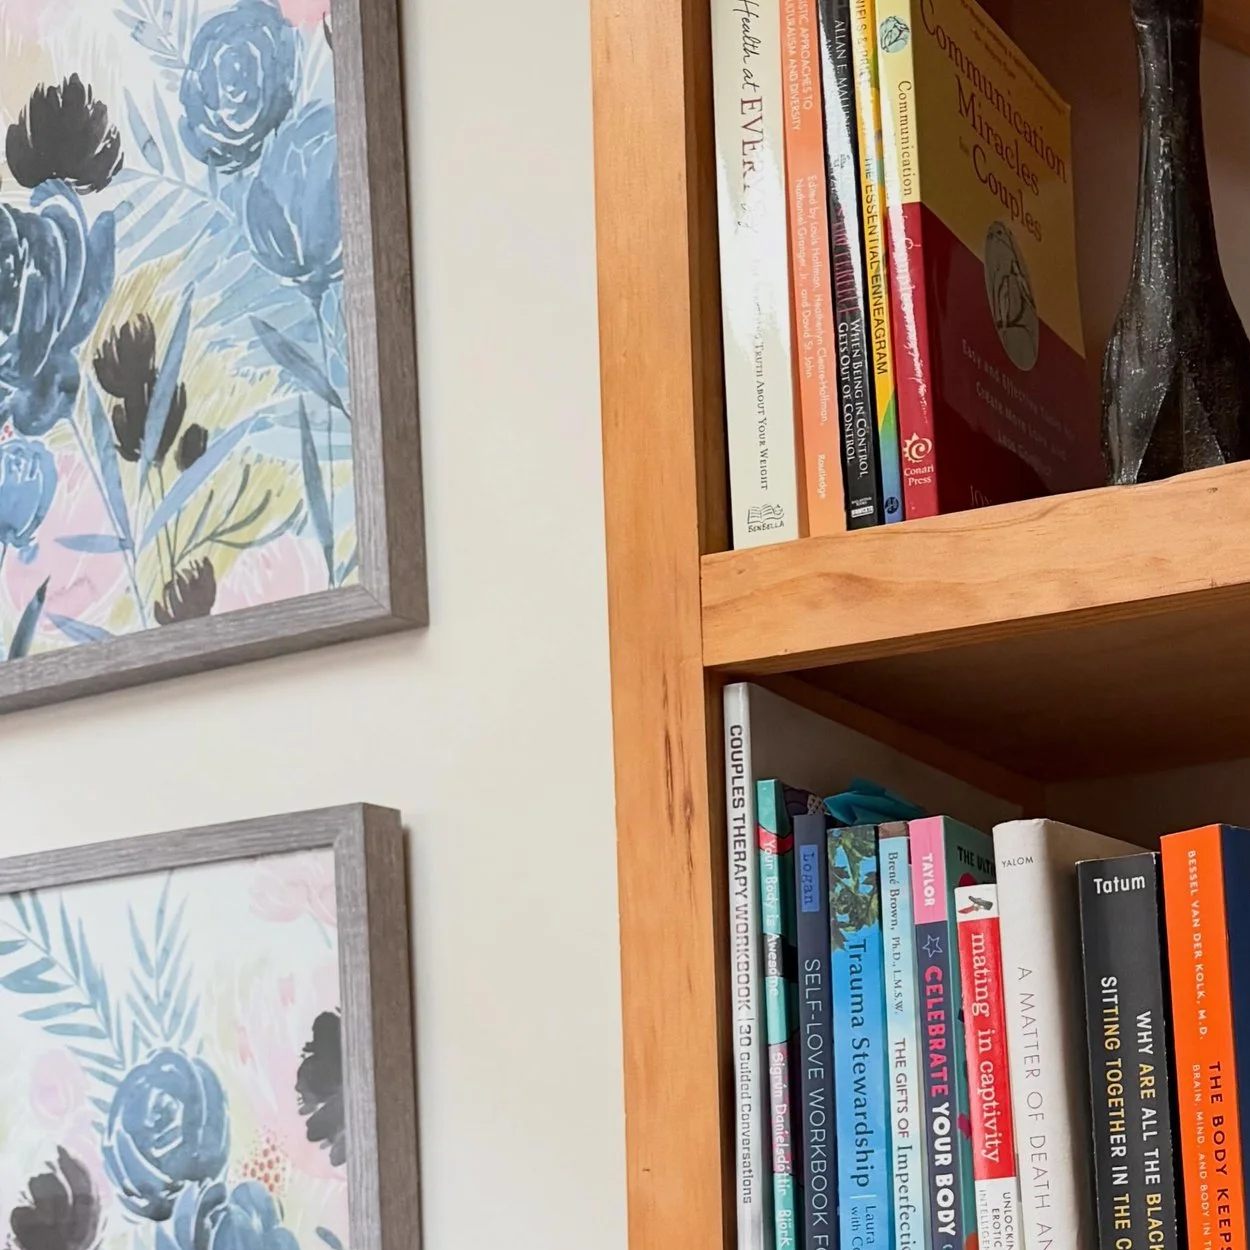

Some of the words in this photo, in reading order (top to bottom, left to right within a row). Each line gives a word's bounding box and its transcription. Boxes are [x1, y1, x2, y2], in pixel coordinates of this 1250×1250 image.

[920, 0, 1068, 184] Communication
[898, 81, 914, 196] Communication
[955, 74, 1040, 196] Miracles
[973, 144, 1041, 242] Couples
[838, 323, 849, 353] GETS
[851, 319, 862, 357] WHEN
[840, 357, 851, 381] OUT
[853, 362, 864, 398] BEING
[842, 385, 852, 401] OF
[855, 402, 866, 415] IN
[843, 405, 856, 463] CONTROL
[856, 419, 869, 477] CONTROL
[818, 454, 827, 498] Routledge
[903, 468, 934, 476] Conari
[908, 478, 931, 486] Press
[922, 853, 936, 906] TAYLOR
[1002, 857, 1033, 867] YALOM
[1094, 876, 1145, 893] Tatum
[849, 939, 868, 1028] Trauma
[970, 933, 993, 1017] mating
[924, 965, 949, 1097] CELEBRATE
[1101, 976, 1120, 1050] SITTING
[1136, 1011, 1153, 1055] WHY
[978, 1028, 995, 1053] in
[1139, 1063, 1155, 1099] ARE
[850, 1037, 874, 1188] Stewardship
[978, 1060, 1002, 1163] captivity
[1105, 1058, 1127, 1157] TOGETHER
[1141, 1107, 1157, 1141] ALL
[931, 1102, 951, 1166] YOUR
[1113, 1166, 1127, 1185] IN
[1144, 1149, 1159, 1185] THE
[865, 1205, 878, 1245] Laura
[936, 1174, 956, 1236] BODY
[1115, 1193, 1130, 1229] THE
[992, 1208, 1002, 1247] EROTIC
